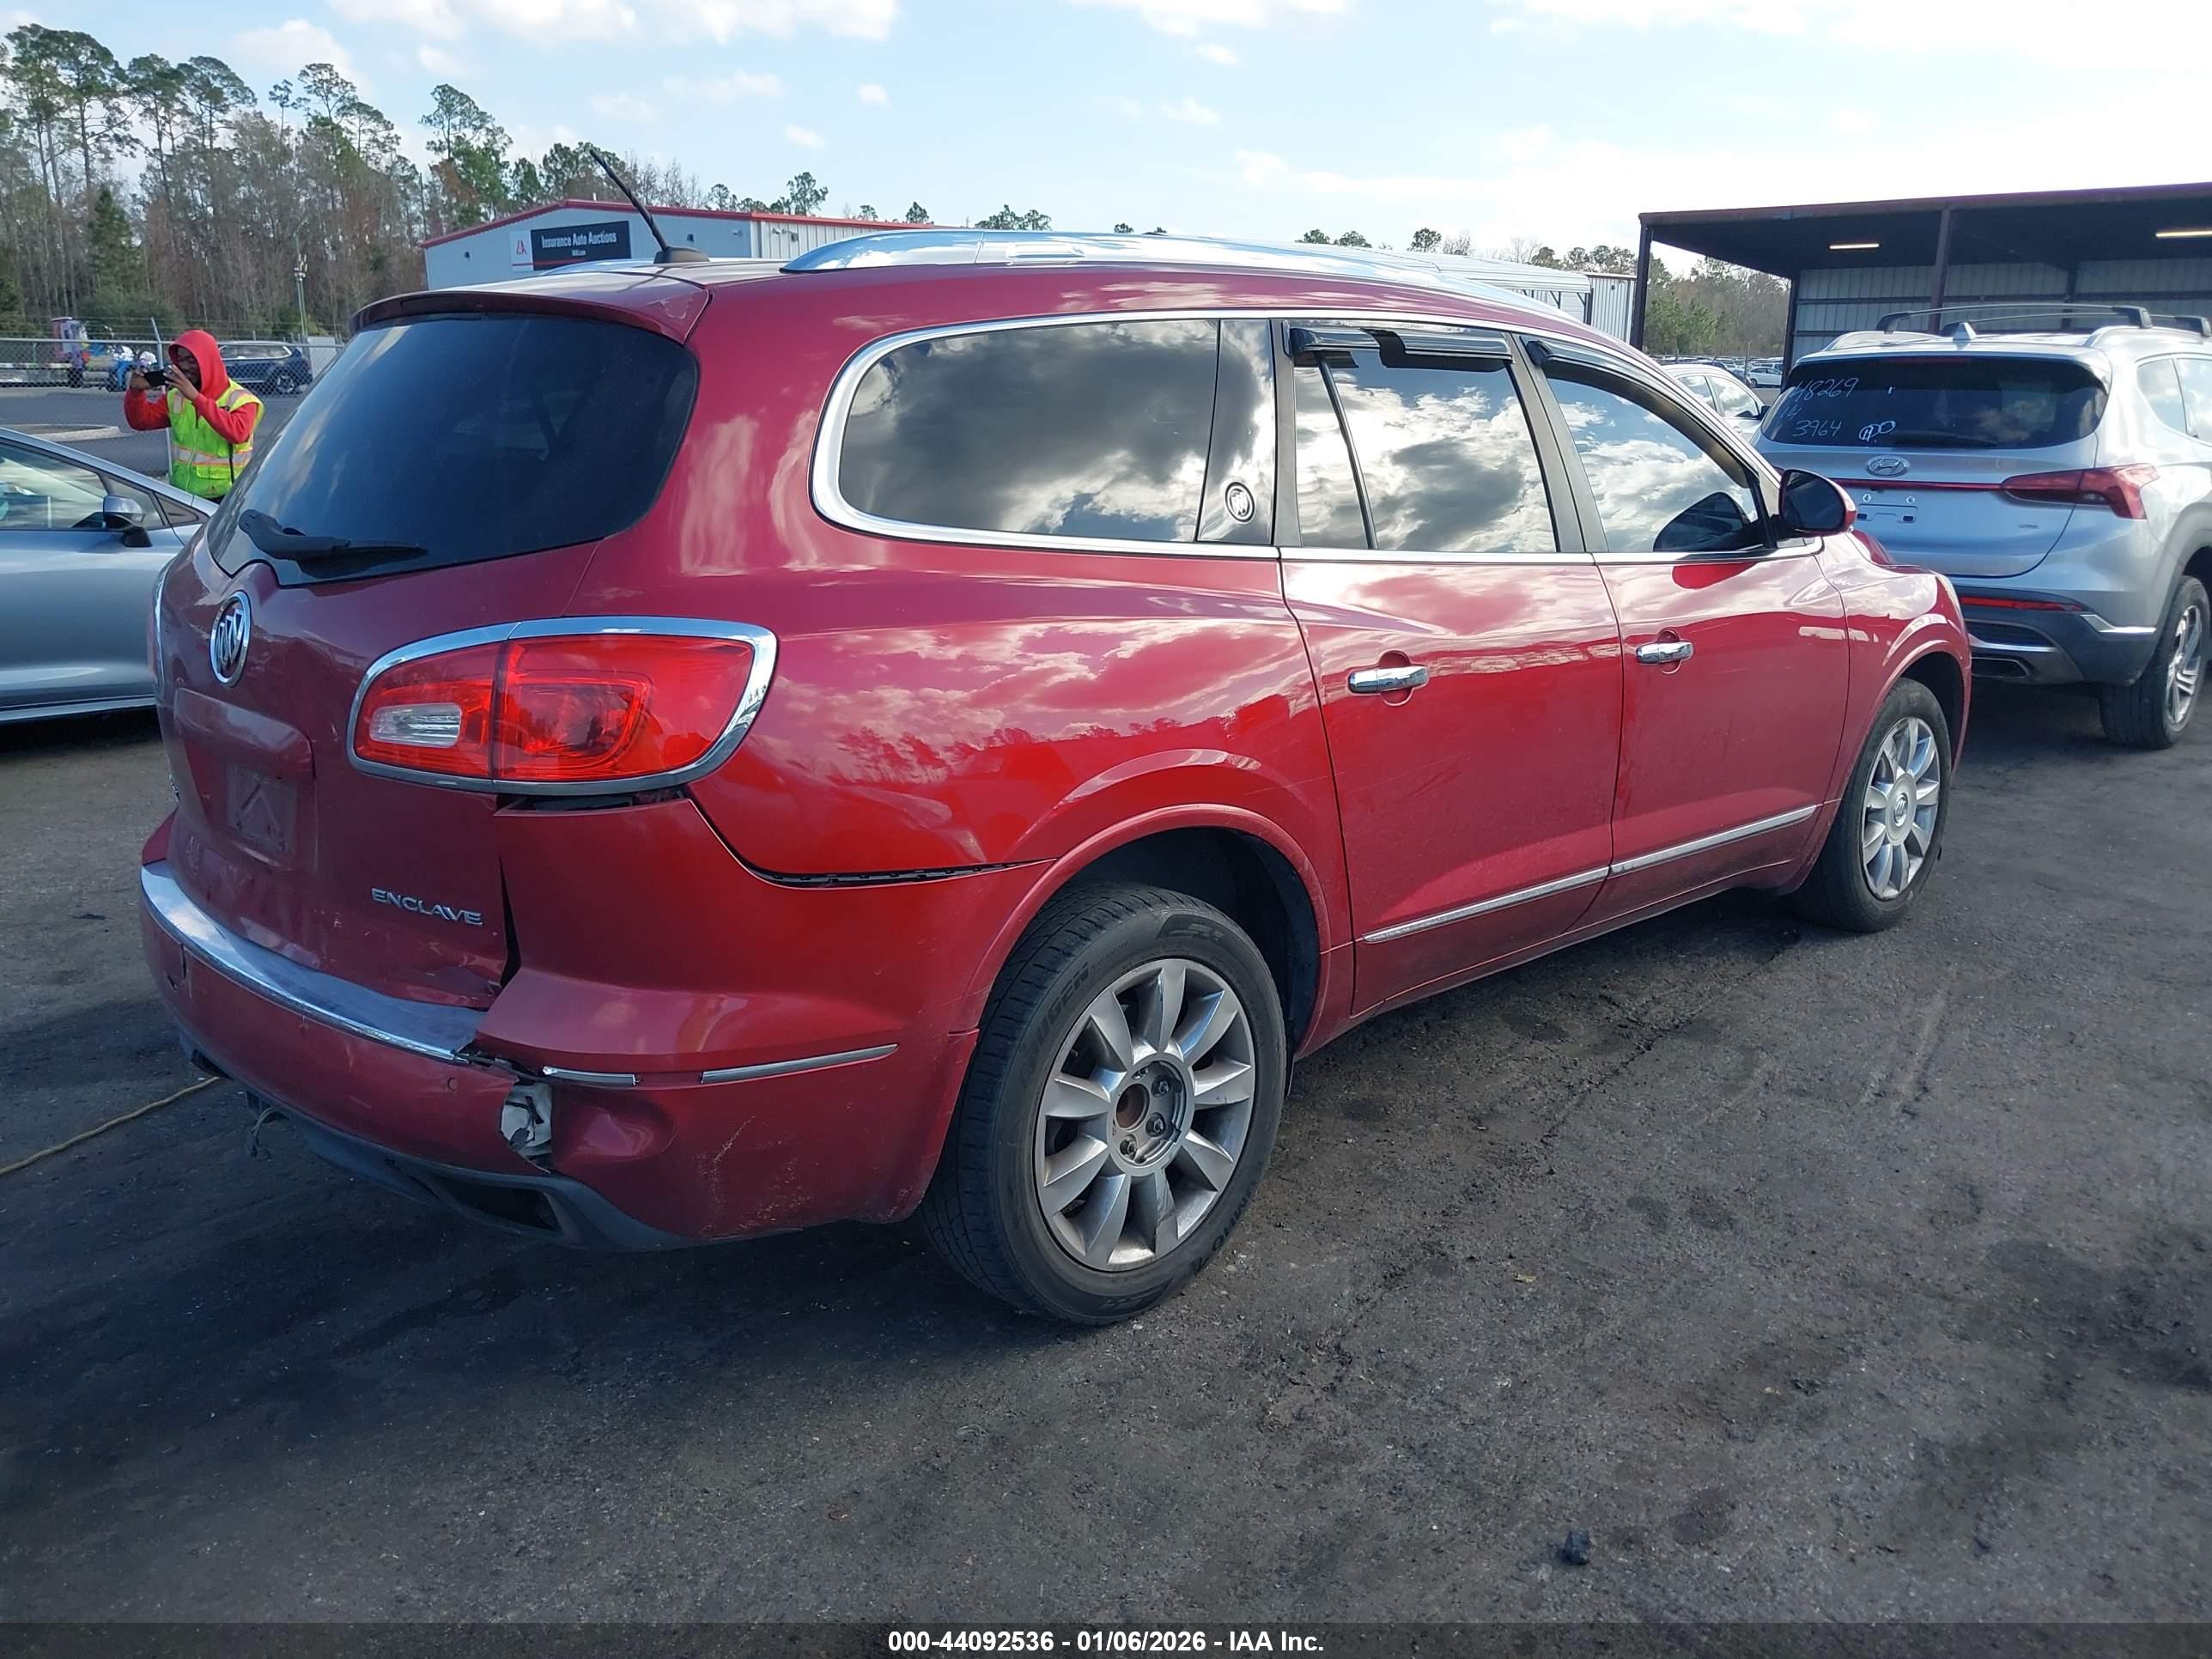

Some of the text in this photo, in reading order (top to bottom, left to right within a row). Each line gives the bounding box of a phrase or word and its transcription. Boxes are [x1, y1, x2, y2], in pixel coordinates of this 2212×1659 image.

[541, 230, 617, 249] Insurance Auto Auctions
[1793, 419, 1842, 437] 3964
[371, 887, 483, 927] ENCLAVE
